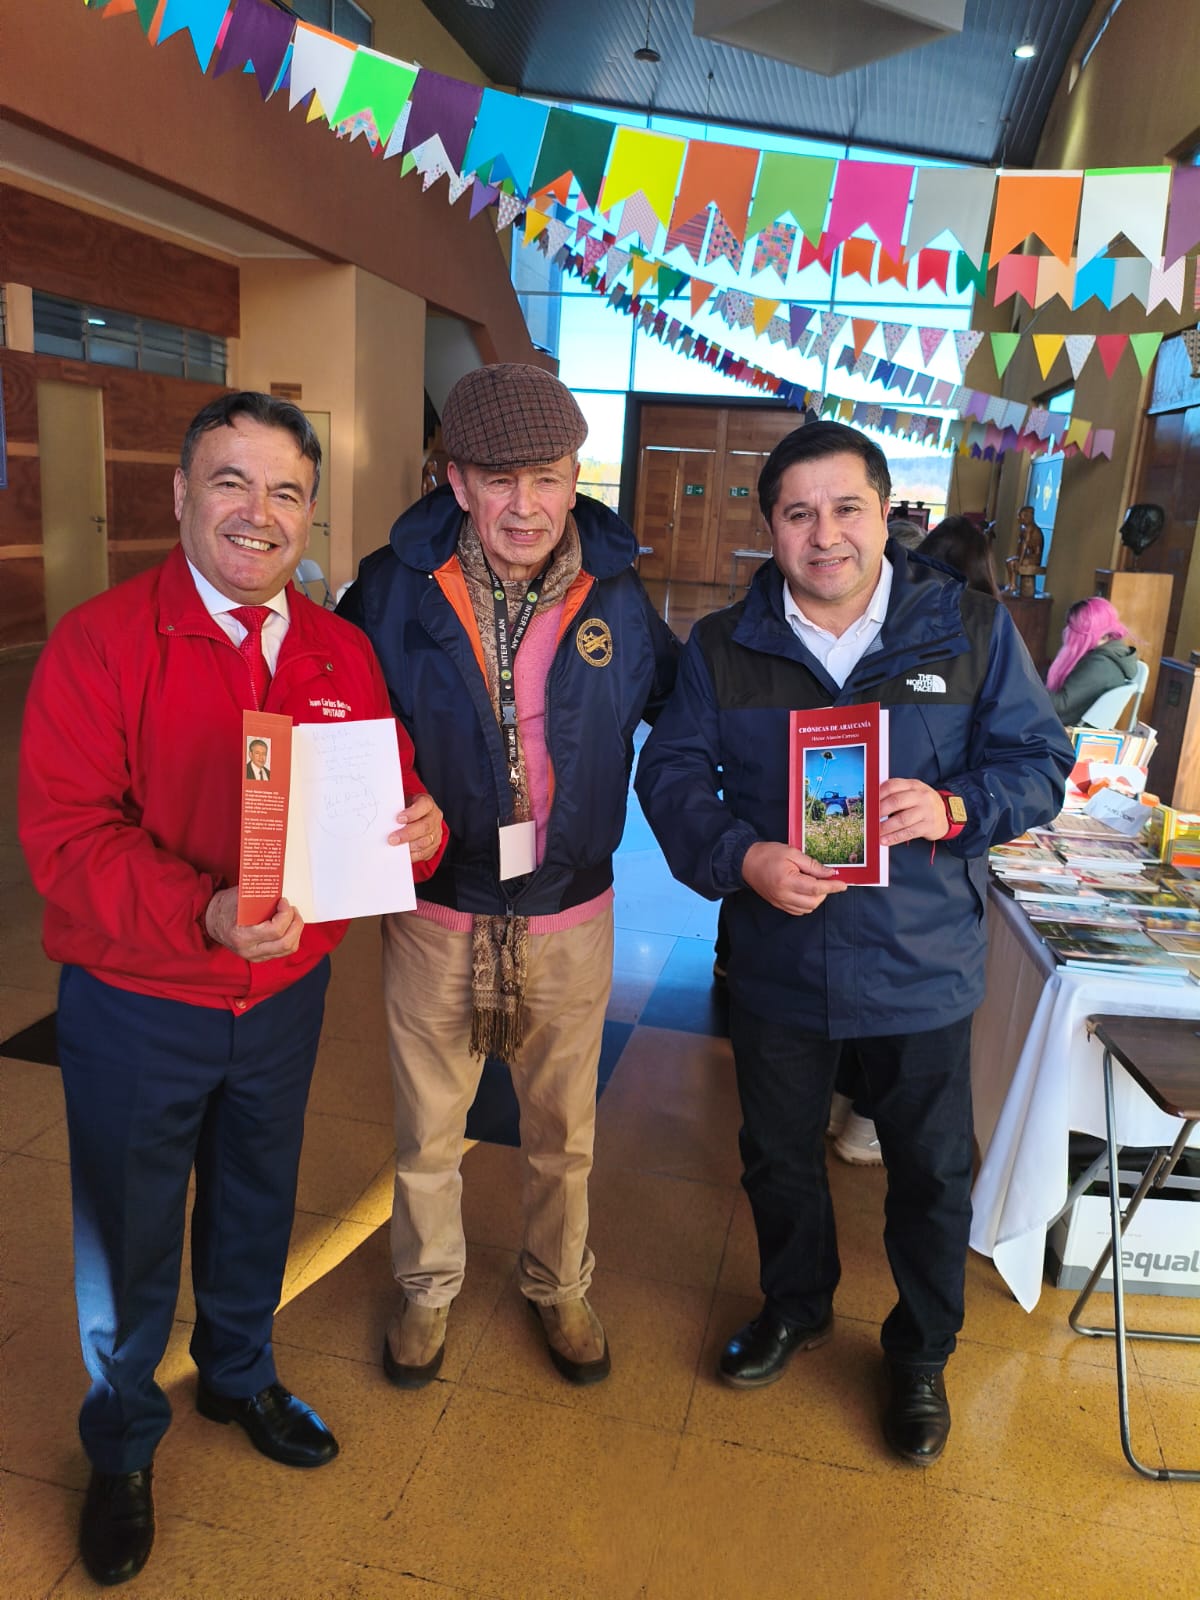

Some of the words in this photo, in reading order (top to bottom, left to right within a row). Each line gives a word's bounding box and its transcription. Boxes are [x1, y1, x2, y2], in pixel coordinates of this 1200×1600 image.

[520, 604, 533, 627] INTER
[498, 618, 507, 643] MILAN
[511, 626, 524, 650] MILAN
[500, 643, 509, 667] INTER
[906, 679, 932, 687] NORTH
[917, 673, 932, 681] THE
[913, 685, 932, 693] FACE
[798, 725, 829, 734] CRÓNICAS
[839, 720, 872, 731] ARAUCANÍA
[1120, 1250, 1200, 1277] equal
